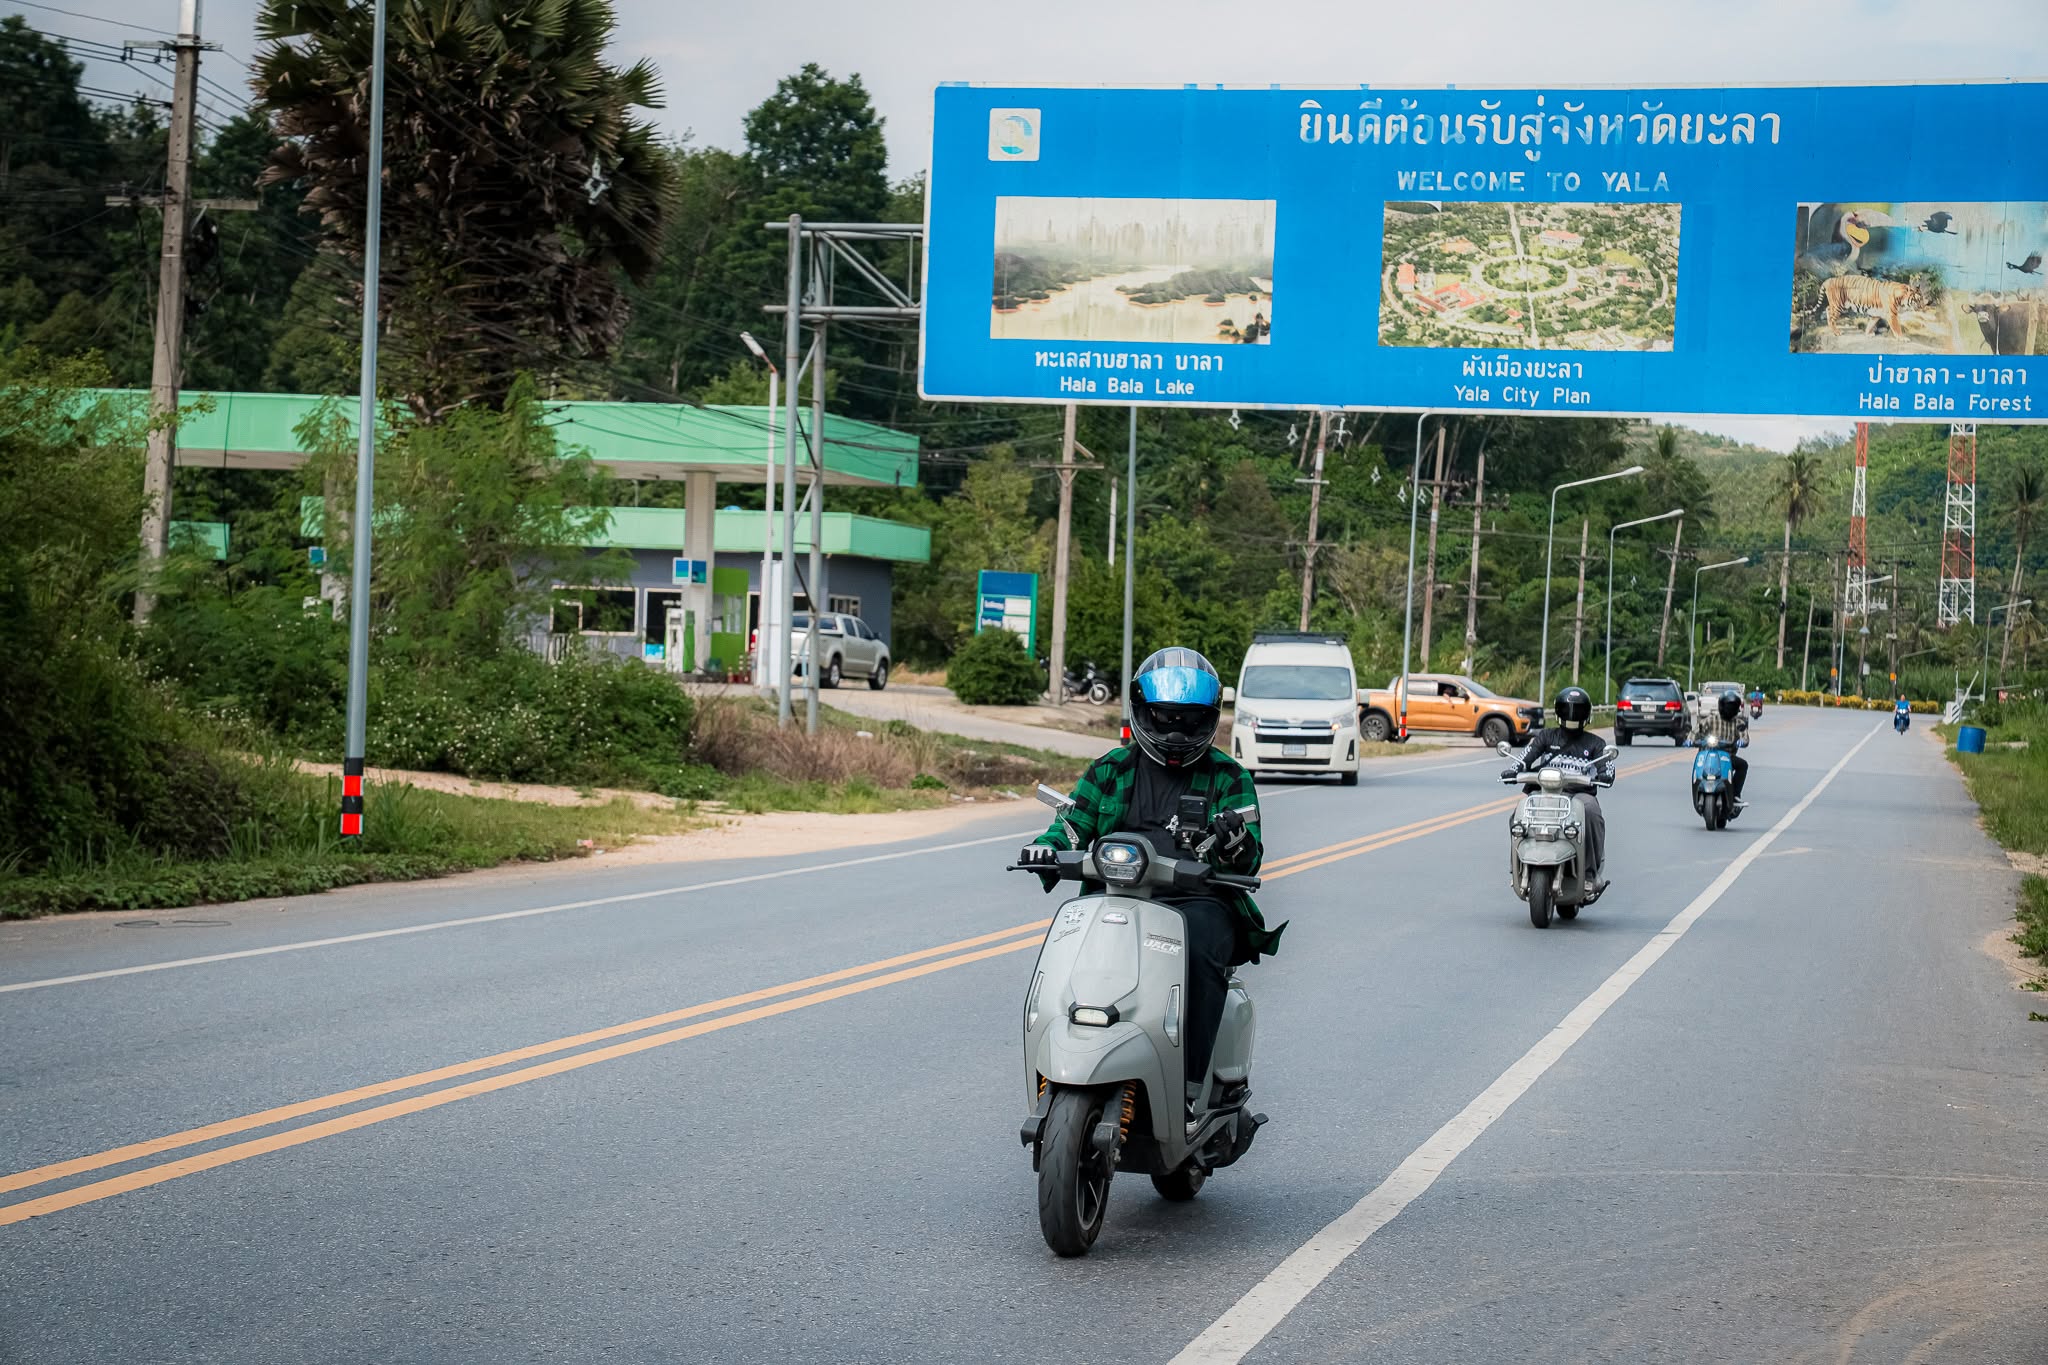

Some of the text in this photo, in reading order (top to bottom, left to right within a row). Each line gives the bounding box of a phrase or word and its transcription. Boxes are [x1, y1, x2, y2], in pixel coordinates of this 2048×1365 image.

[1299, 94, 1781, 162] ยินดีต้อนรับสู่จังหวัดยะลา
[1397, 170, 1670, 192] WELCOME TO YALA
[1035, 350, 1223, 371] ทะเลสาบฮาลา บาลา
[1462, 354, 1584, 379] ผังเมืองยะลา
[1868, 354, 1950, 385] ป่าฮาลา
[1971, 367, 2028, 385] บาลา
[1060, 376, 1195, 395] Hala Bala Lake
[1454, 384, 1591, 408] Yala City Plan
[1859, 392, 2032, 412] Hala Bala Forest
